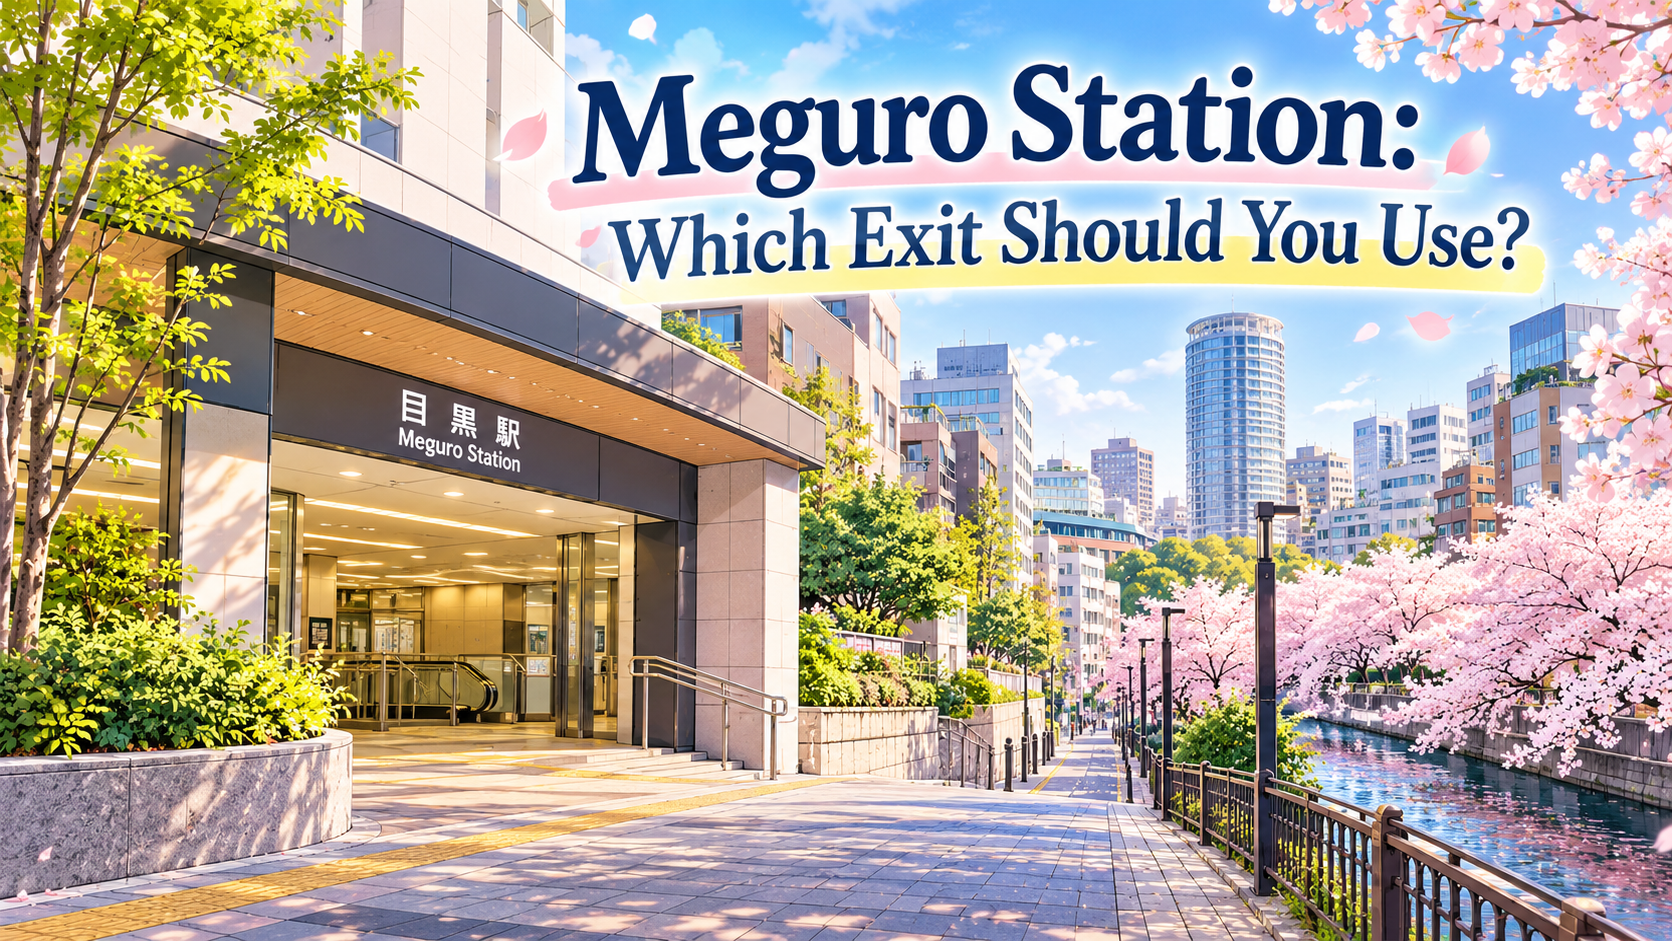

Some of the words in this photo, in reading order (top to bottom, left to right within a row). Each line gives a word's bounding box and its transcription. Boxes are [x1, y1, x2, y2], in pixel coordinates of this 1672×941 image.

[401, 388, 521, 450] 目黒駅
[398, 426, 464, 459] Meguro
[467, 443, 521, 473] Station
